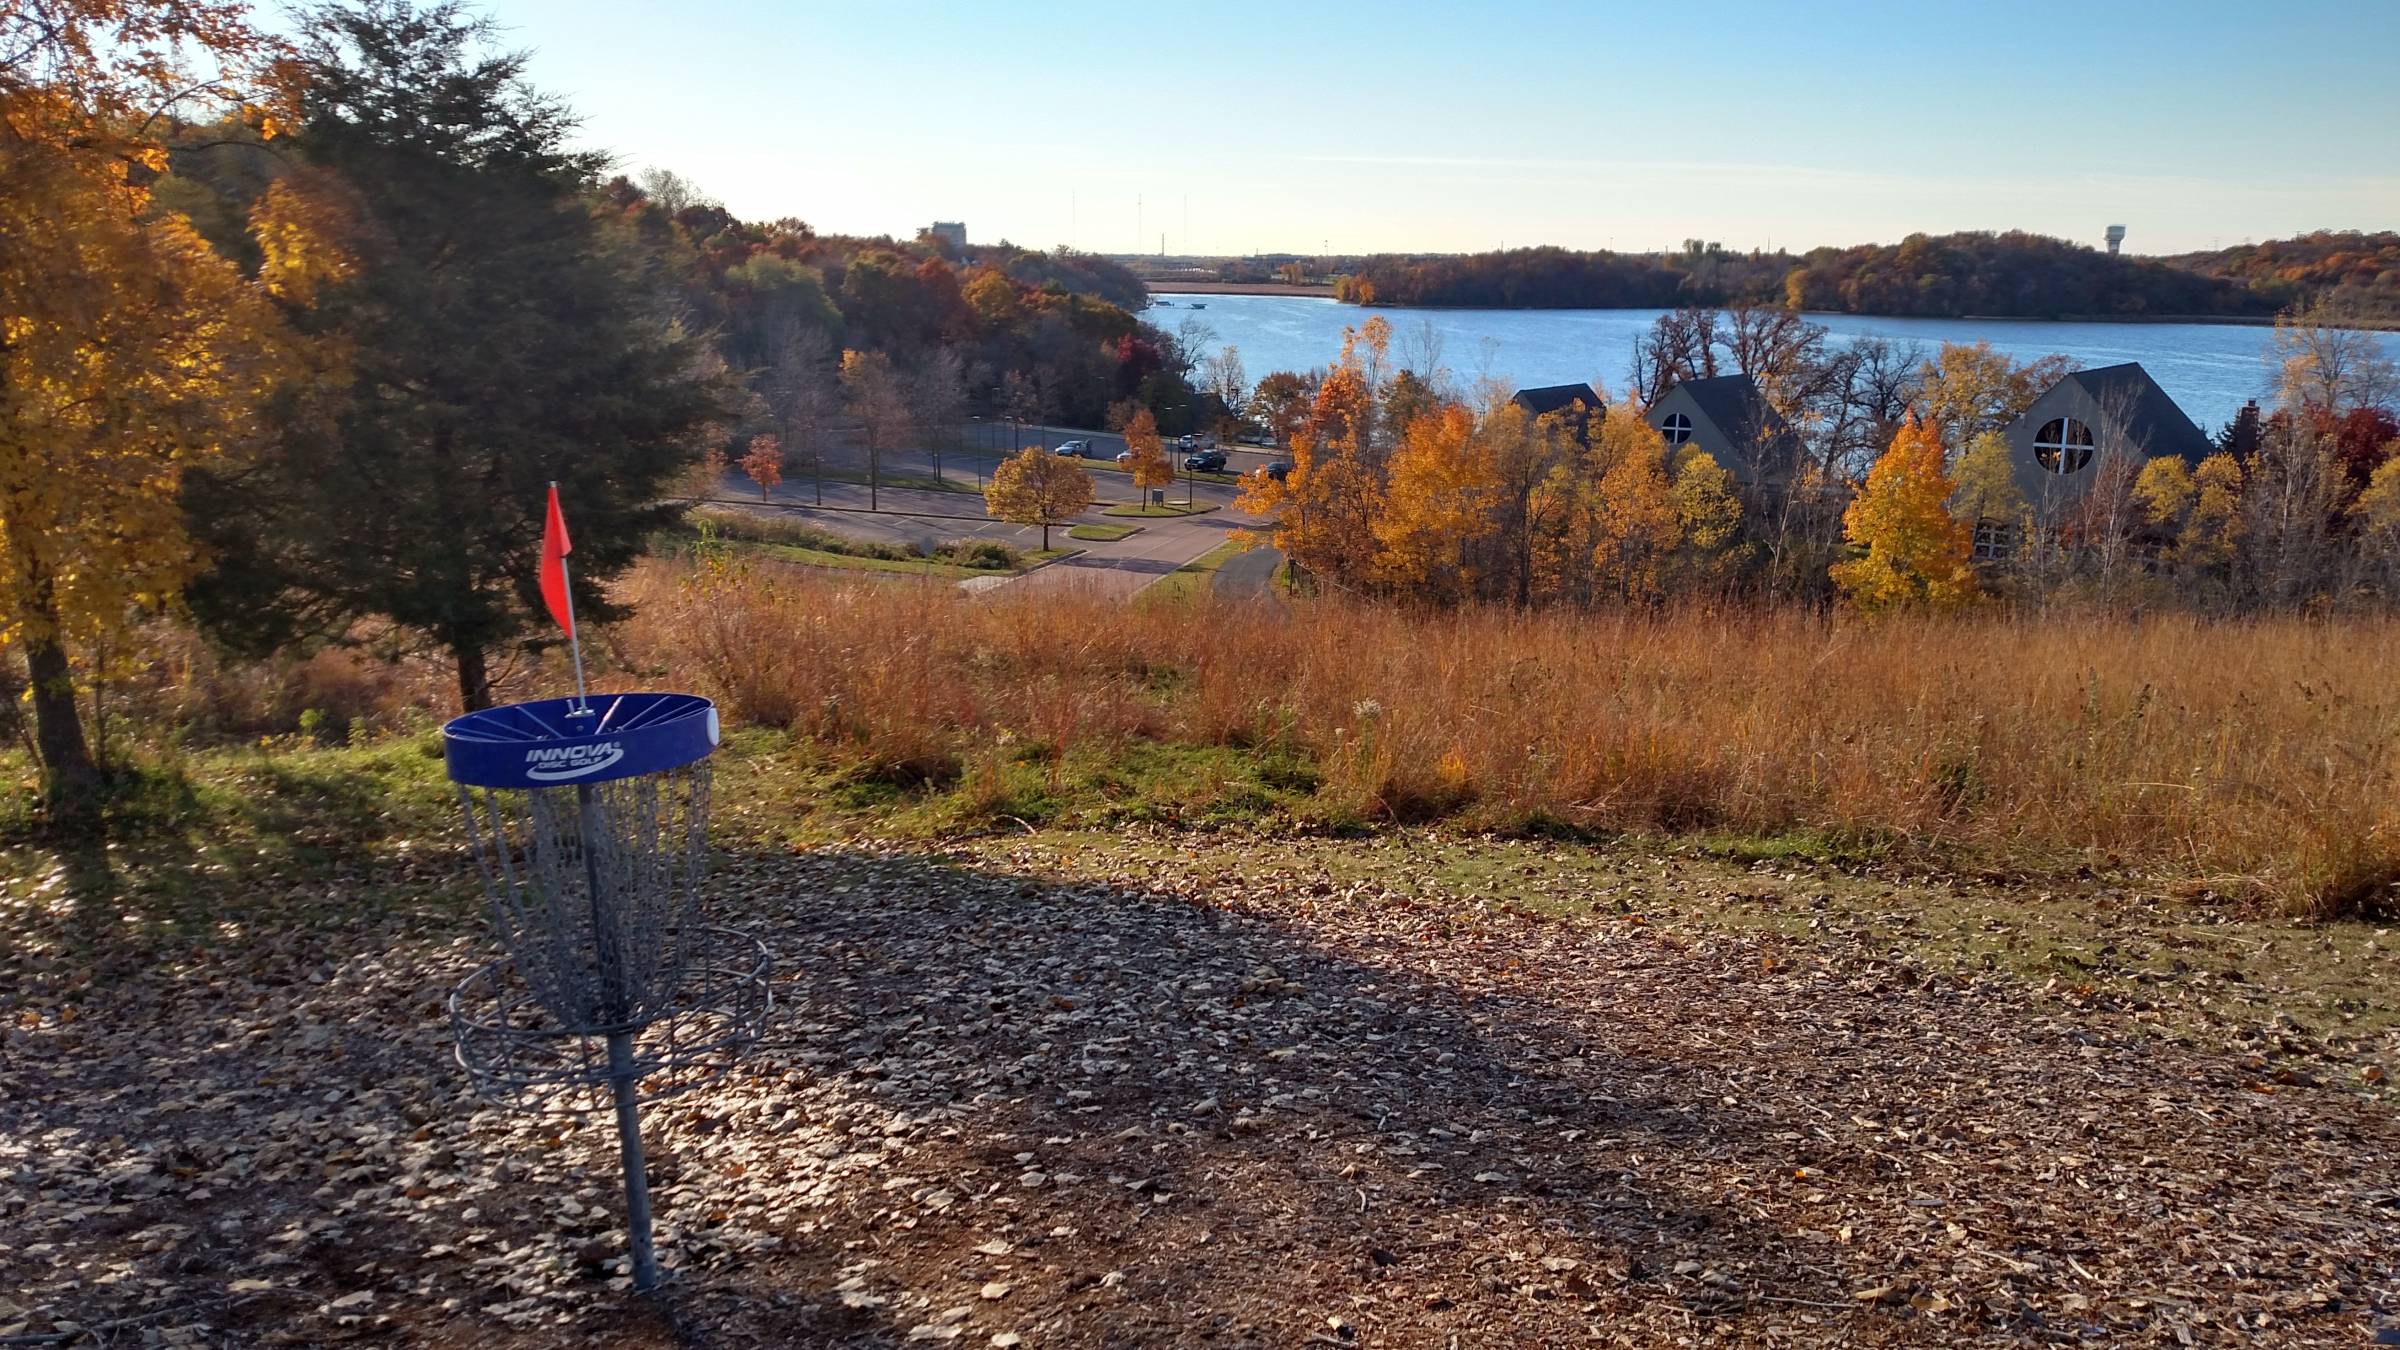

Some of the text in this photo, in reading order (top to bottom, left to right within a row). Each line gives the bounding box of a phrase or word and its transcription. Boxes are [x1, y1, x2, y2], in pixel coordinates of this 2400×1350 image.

[525, 742, 612, 762] INNOVA
[537, 756, 603, 769] DISC GOLF
